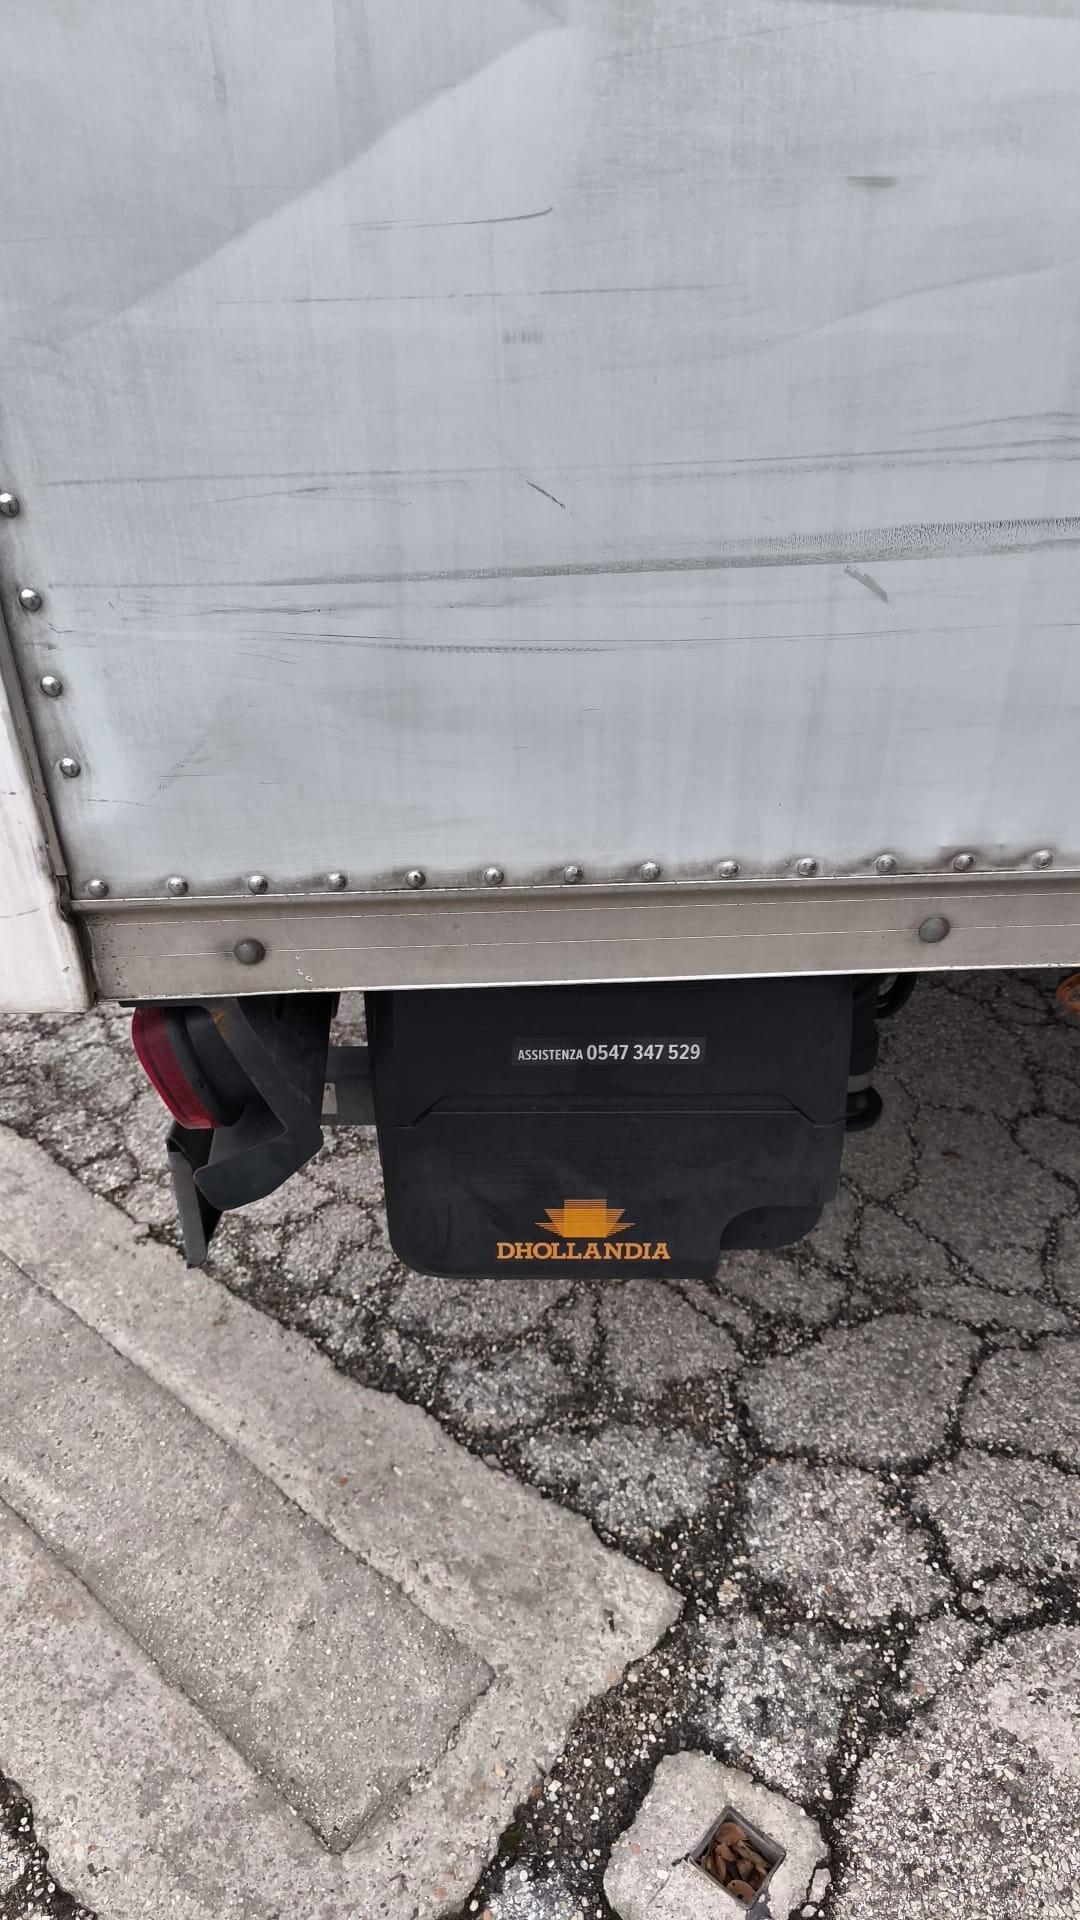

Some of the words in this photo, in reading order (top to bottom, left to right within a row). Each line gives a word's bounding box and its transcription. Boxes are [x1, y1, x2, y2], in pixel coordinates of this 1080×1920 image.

[517, 1048, 584, 1061] ASSISTENZA
[586, 1043, 629, 1060] 0547
[632, 1043, 665, 1060] 347
[667, 1043, 701, 1060] 529
[496, 1242, 671, 1260] DHOLLANDIA
